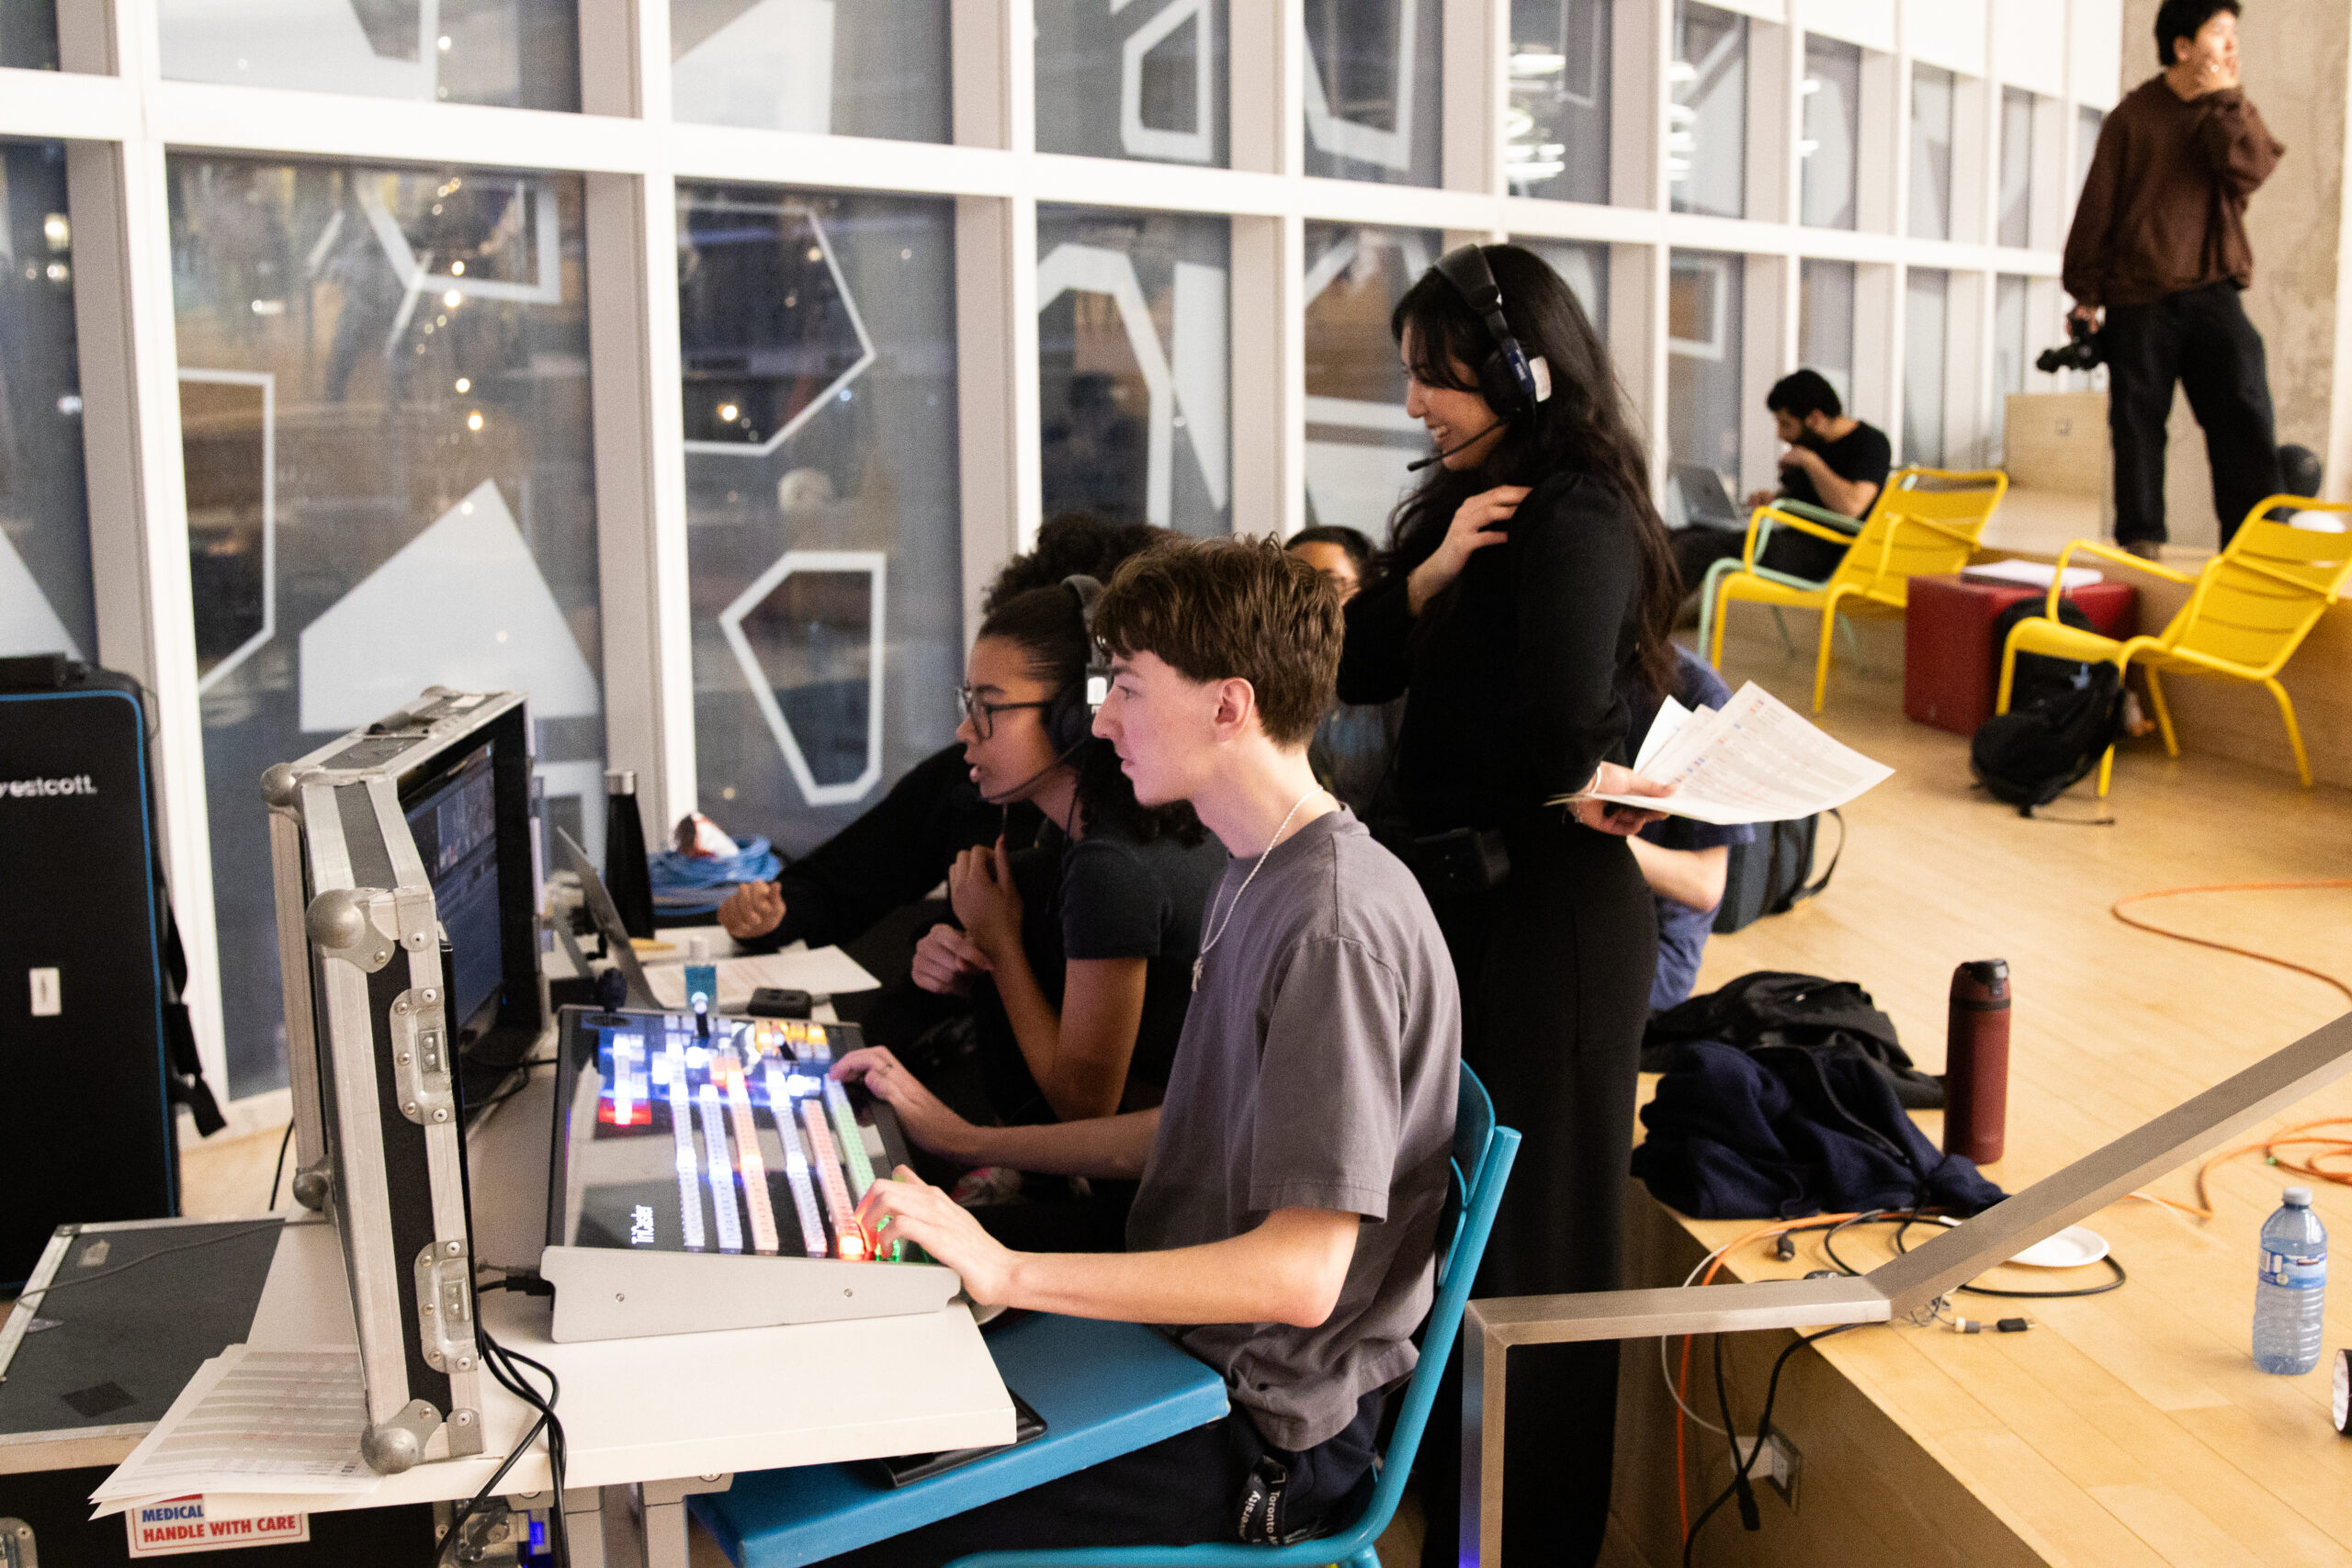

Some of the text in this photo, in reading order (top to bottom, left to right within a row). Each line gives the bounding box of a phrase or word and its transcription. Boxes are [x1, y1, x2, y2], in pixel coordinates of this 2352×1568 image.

[630, 1204, 654, 1245] TriCaster
[141, 1505, 204, 1523] MEDICAL
[142, 1515, 296, 1543] HANDLE WITH CARE
[1266, 1490, 1281, 1534] Toronto
